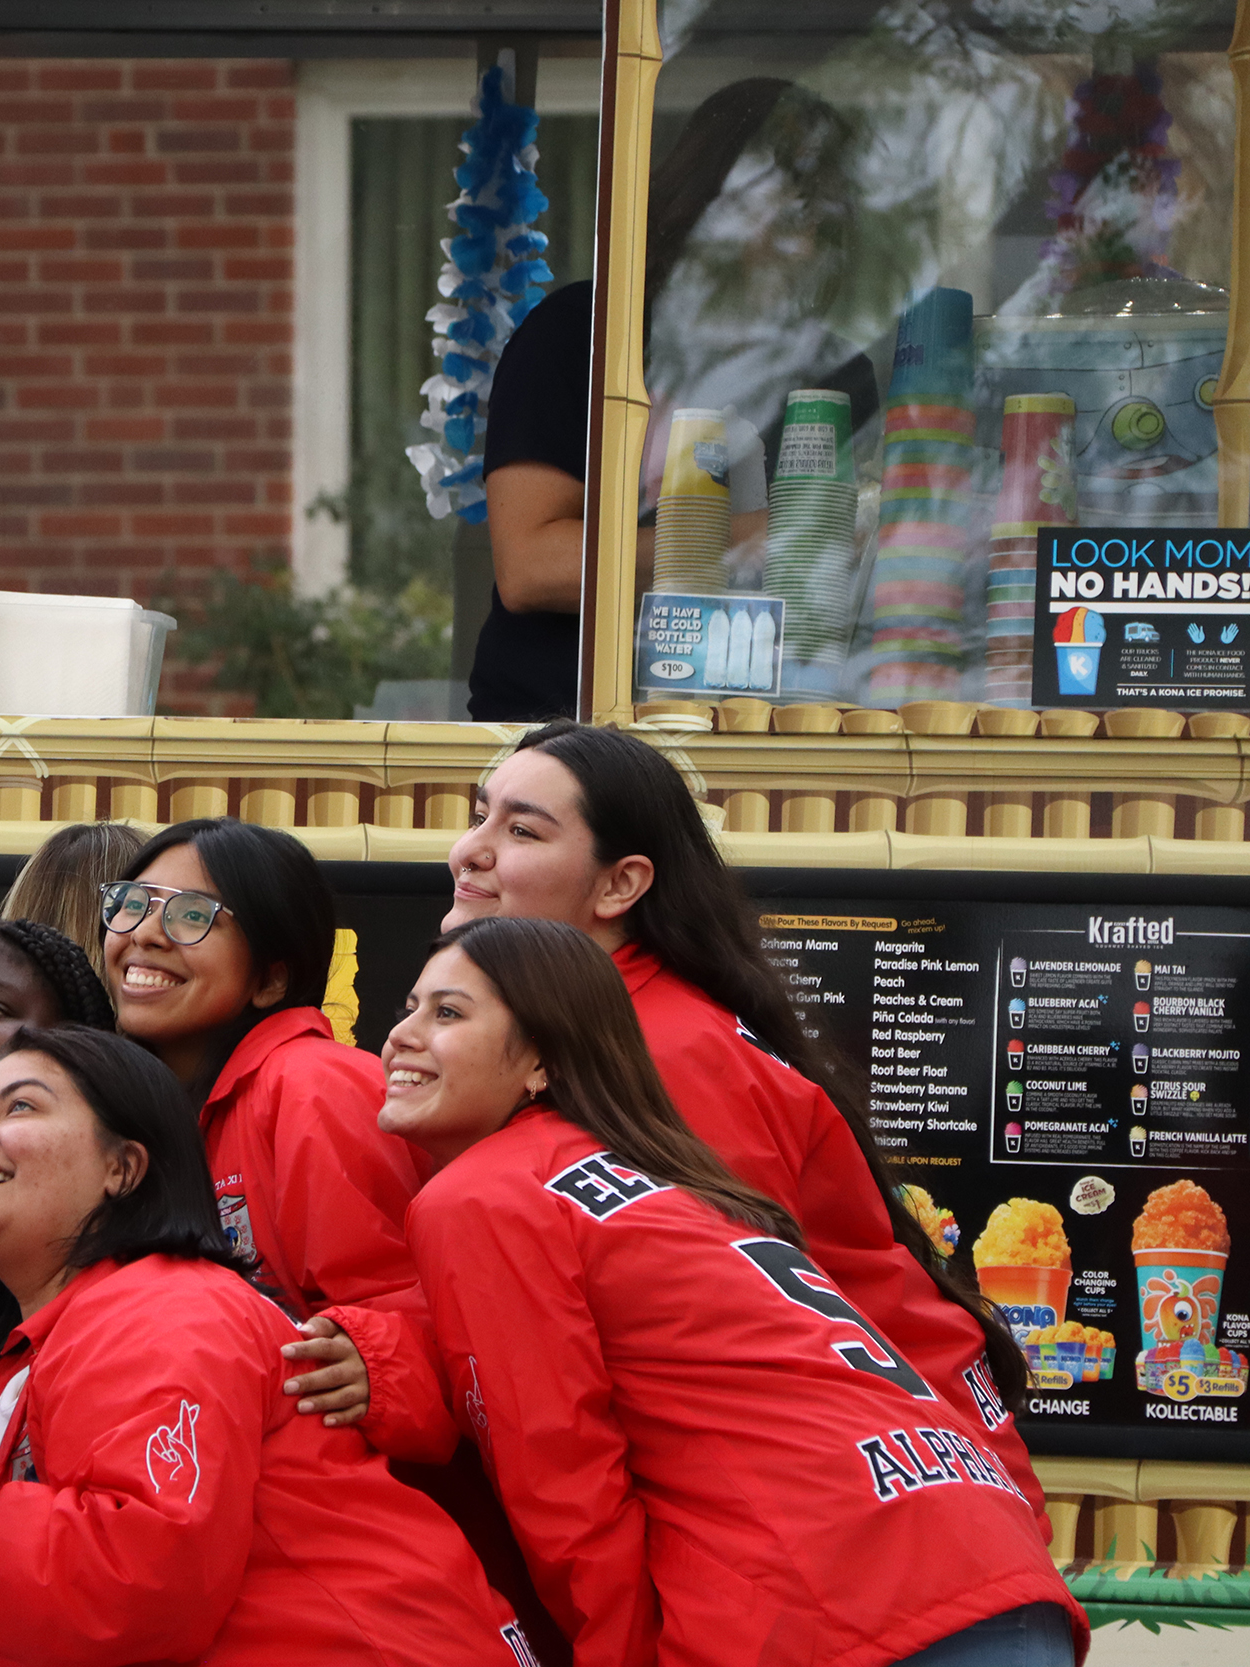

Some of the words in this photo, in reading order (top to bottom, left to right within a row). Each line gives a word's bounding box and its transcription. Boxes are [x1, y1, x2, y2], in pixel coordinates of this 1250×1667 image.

[1053, 539, 1155, 568] LOOK
[1165, 539, 1250, 568] MOM
[1051, 571, 1105, 598] NO
[1113, 572, 1250, 600] HANDS!
[653, 606, 669, 617] WE
[673, 607, 702, 619] HAVE
[649, 618, 667, 629] ICE
[671, 619, 703, 631] COLD
[648, 630, 703, 644] BOTTLED
[655, 643, 693, 656] WATER
[1070, 655, 1088, 676] K
[1117, 688, 1148, 696] THAT'S
[1187, 689, 1202, 697] ICE
[1204, 689, 1247, 698] PROMISE.
[777, 918, 796, 927] Pour
[798, 918, 820, 927] These
[821, 919, 848, 928] Flavors
[850, 919, 860, 929] By
[861, 920, 893, 930] Request
[913, 917, 937, 927] ahead,
[1089, 916, 1175, 945] Krafted
[761, 938, 803, 951] Bahama
[805, 939, 839, 952] Mama
[874, 940, 925, 956] Margarita
[874, 958, 918, 972] Paradise
[921, 959, 943, 972] Pink
[945, 960, 980, 973] Lemon
[1030, 960, 1074, 972] LAVENDER
[1075, 962, 1122, 973] LEMONADE
[1154, 965, 1171, 975] MAI
[1172, 965, 1186, 975] TAI
[789, 974, 823, 989] Cherry
[874, 976, 905, 989] Peach
[824, 992, 846, 1004] Pink
[873, 993, 916, 1007] Peaches
[918, 994, 927, 1007] &
[929, 995, 964, 1008] Cream
[1028, 997, 1077, 1008] BLUEBERRY
[1078, 998, 1099, 1009] ACAI
[1153, 997, 1196, 1007] BOURBON
[1197, 998, 1226, 1008] BLACK
[872, 1010, 896, 1025] Piña
[897, 1011, 934, 1025] Colada
[1153, 1006, 1187, 1016] CHERRY
[1188, 1007, 1225, 1017] VANILLA
[872, 1028, 892, 1042] Red
[894, 1029, 946, 1045] Raspberry
[871, 1046, 895, 1059] Root
[897, 1047, 921, 1060] Beer
[1026, 1044, 1076, 1055] CARIBBEAN
[1077, 1045, 1111, 1056] CHERRY
[1151, 1047, 1207, 1059] BLACKBERRY
[1208, 1049, 1241, 1060] MOJITO
[871, 1064, 895, 1077] Root
[896, 1064, 921, 1077] Beer
[923, 1065, 948, 1078] Float
[870, 1081, 926, 1097] Strawberry
[928, 1083, 968, 1096] Banana
[1025, 1080, 1066, 1091] COCONUT
[1067, 1081, 1088, 1092] LIME
[1150, 1081, 1181, 1091] CITRUS
[1182, 1081, 1207, 1092] SOUR
[1150, 1090, 1188, 1100] SWIZZLE
[869, 1099, 925, 1115] Strawberry
[927, 1101, 950, 1113] Kiwi
[869, 1117, 925, 1132] Strawberry
[926, 1118, 978, 1132] Shortcake
[1024, 1121, 1088, 1132] POMEGRANATE
[1089, 1123, 1110, 1133] ACAI
[1149, 1131, 1184, 1142] FRENCH
[1184, 1132, 1221, 1143] VANILLA
[1222, 1133, 1248, 1144] LATTE
[907, 1157, 929, 1166] UPON
[929, 1157, 963, 1166] REQUEST
[1081, 1183, 1096, 1193] ICE
[1075, 1187, 1107, 1203] CREAM
[1082, 1270, 1110, 1279] COLOR
[1074, 1279, 1117, 1288] CHANGING
[1084, 1286, 1106, 1295] CUPS
[731, 1236, 940, 1403] 5
[1225, 1313, 1250, 1322] KONA
[1226, 1330, 1248, 1338] CUPS
[1041, 1375, 1069, 1386] Refills
[1168, 1374, 1191, 1396] $5
[1199, 1380, 1213, 1394] $3
[1213, 1382, 1240, 1393] Refills
[1029, 1397, 1091, 1416] CHANGE
[1145, 1403, 1239, 1423] KOLLECTABLE
[855, 1427, 1016, 1504] ALPHA
